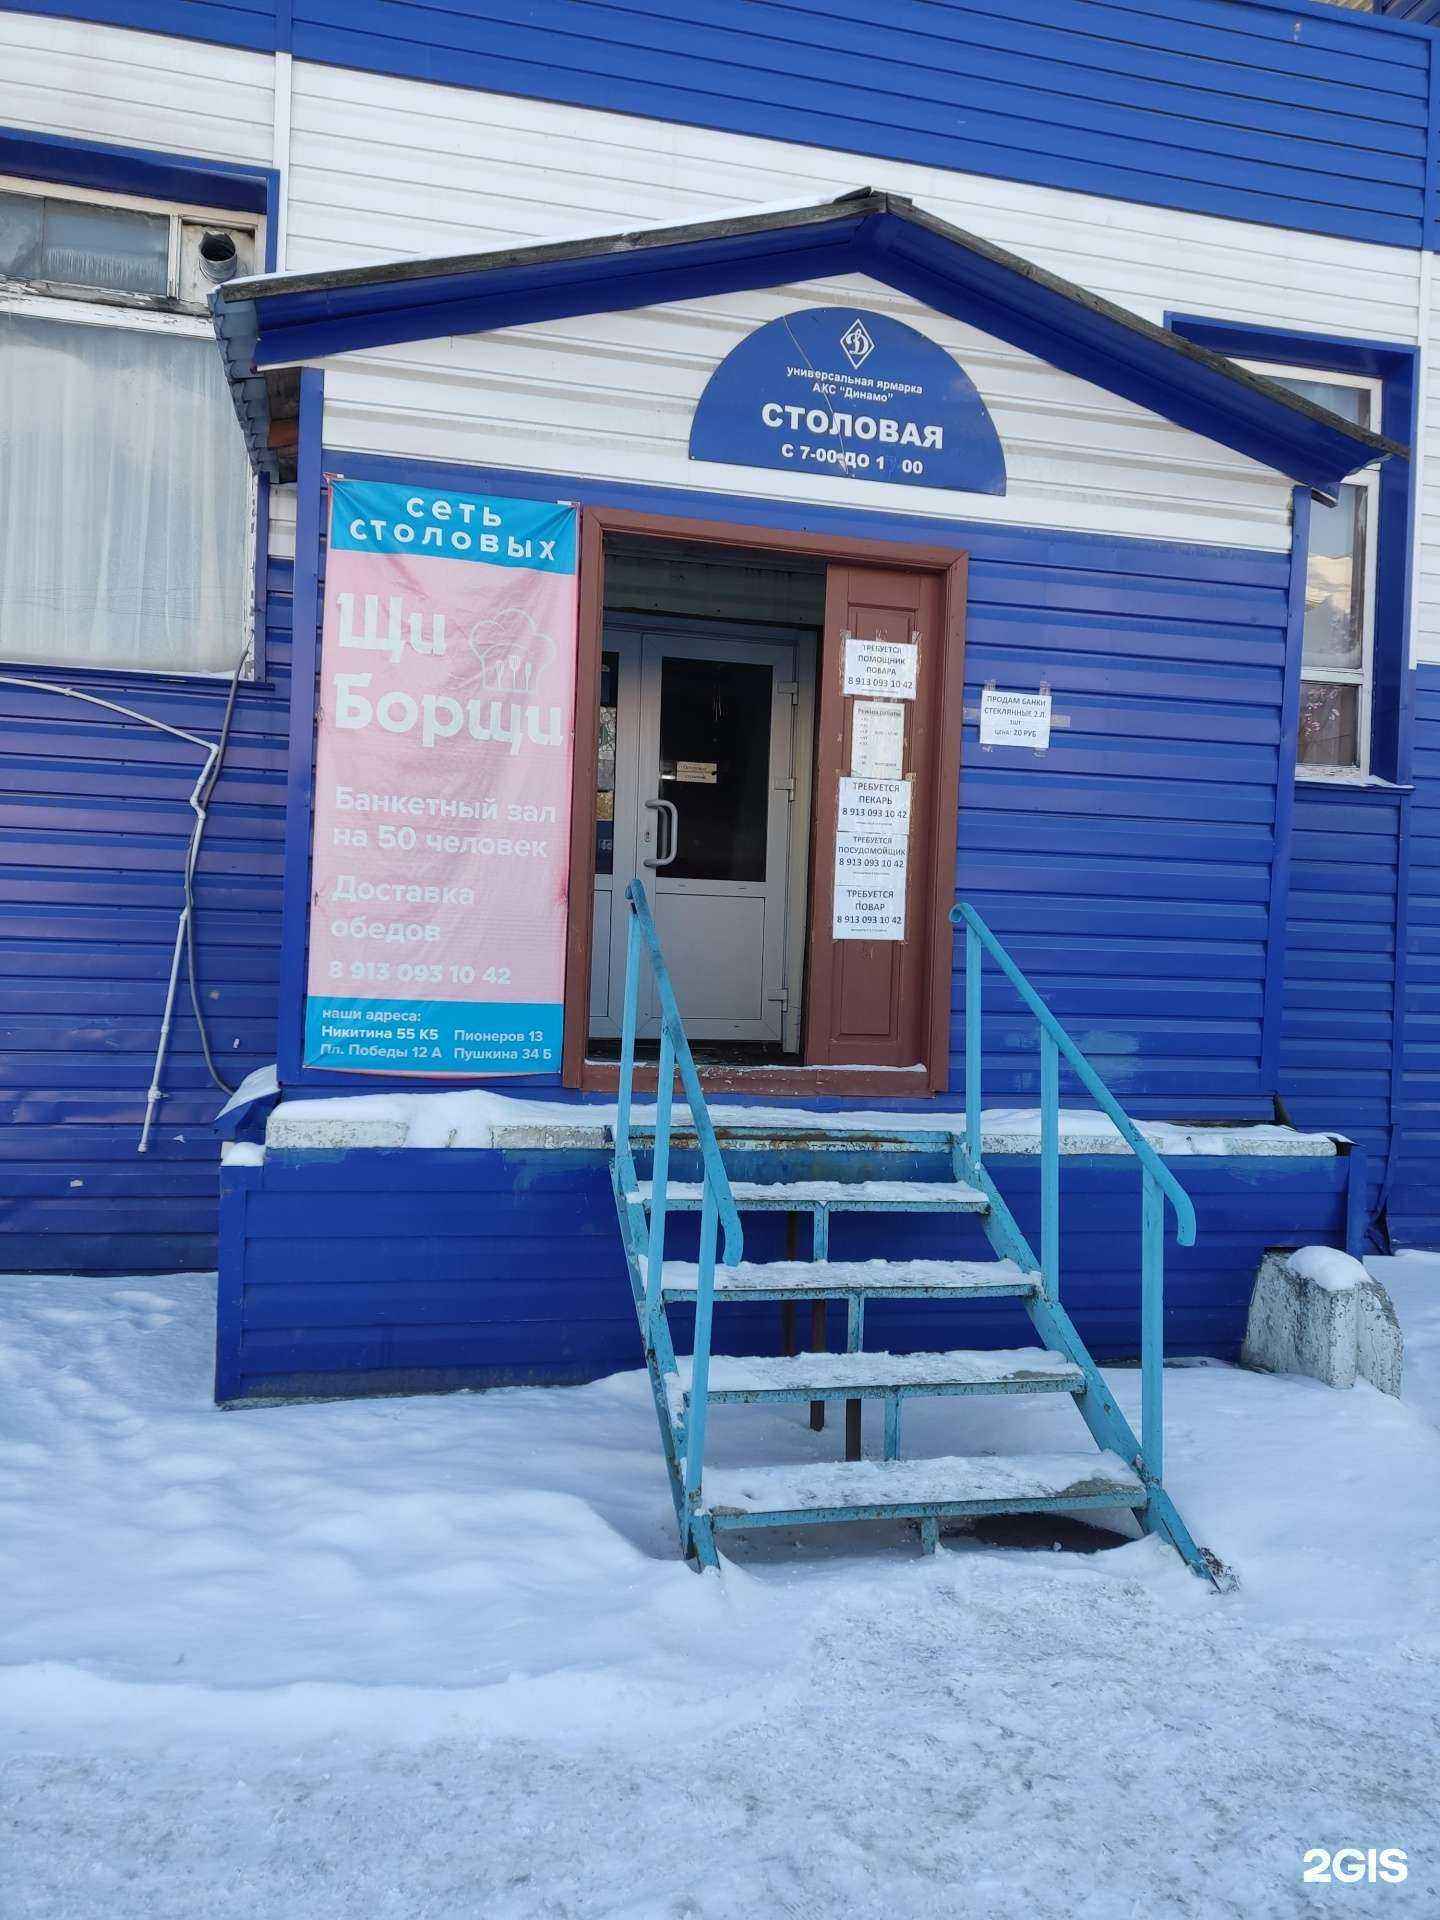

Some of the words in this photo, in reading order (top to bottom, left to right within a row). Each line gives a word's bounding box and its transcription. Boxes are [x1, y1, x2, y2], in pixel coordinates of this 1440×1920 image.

[786, 366, 874, 386] универсальная
[877, 380, 922, 394] ярмарка
[812, 382, 836, 394] АКС
[761, 402, 944, 450] СТОЛОВАЯ
[406, 497, 502, 527] сеть
[350, 519, 556, 561] столовых
[336, 592, 447, 664] Щи
[863, 644, 903, 654] ТРЕБУЕТСЯ
[858, 655, 906, 665] ПОМОЩНИК
[866, 666, 896, 676] ПОВАРА
[848, 676, 854, 685] 8
[856, 678, 870, 686] 913
[873, 679, 888, 688] 093
[890, 680, 900, 688] 10
[902, 681, 913, 689] 42
[987, 696, 1020, 704] ПРОДАМ
[1022, 698, 1046, 706] БАНКИ
[333, 672, 564, 756] Борщи
[852, 782, 900, 792] ТРЕБУЕТСЯ
[335, 784, 498, 820] Банкетный
[507, 804, 556, 824] зал
[859, 795, 893, 805] ПЕКАРЬ
[842, 808, 848, 816] 8
[850, 808, 866, 816] 913
[867, 808, 882, 817] 093
[885, 810, 895, 818] 10
[897, 810, 907, 818] 42
[333, 826, 368, 848] на
[378, 824, 417, 850] 50
[426, 833, 548, 858] человек
[853, 836, 892, 844] ТРЕБУЕТСЯ
[838, 846, 906, 856] ПОСУДОМОЙЩИК
[839, 858, 844, 866] 8
[846, 858, 862, 866] 913
[864, 858, 880, 868] 093
[882, 860, 892, 868] 10
[894, 860, 904, 868] 42
[330, 874, 474, 905] Доставка
[846, 889, 894, 899] ТРЕБУЕТСЯ
[854, 902, 886, 911] ПОВАР
[836, 915, 842, 924] 8
[844, 916, 860, 924] 913
[862, 916, 878, 924] 093
[880, 916, 890, 924] 10
[892, 916, 902, 924] 42
[330, 916, 442, 944] обедов
[328, 960, 342, 978] 8
[350, 962, 390, 980] 913
[398, 963, 443, 982] 093
[450, 965, 476, 984] 10
[482, 966, 512, 986] 42
[322, 1008, 362, 1020] наши
[366, 1010, 422, 1023] адреса:
[320, 1025, 392, 1040] Никитина
[396, 1027, 415, 1040] 55
[419, 1028, 438, 1040] К5
[454, 1030, 524, 1044] Пионеров
[528, 1030, 544, 1042] 13
[320, 1044, 344, 1056] Пл.
[348, 1044, 408, 1058] Победы
[412, 1046, 428, 1058] 12
[431, 1047, 442, 1059] А
[454, 1047, 518, 1062] Пушкина
[522, 1048, 540, 1060] 34
